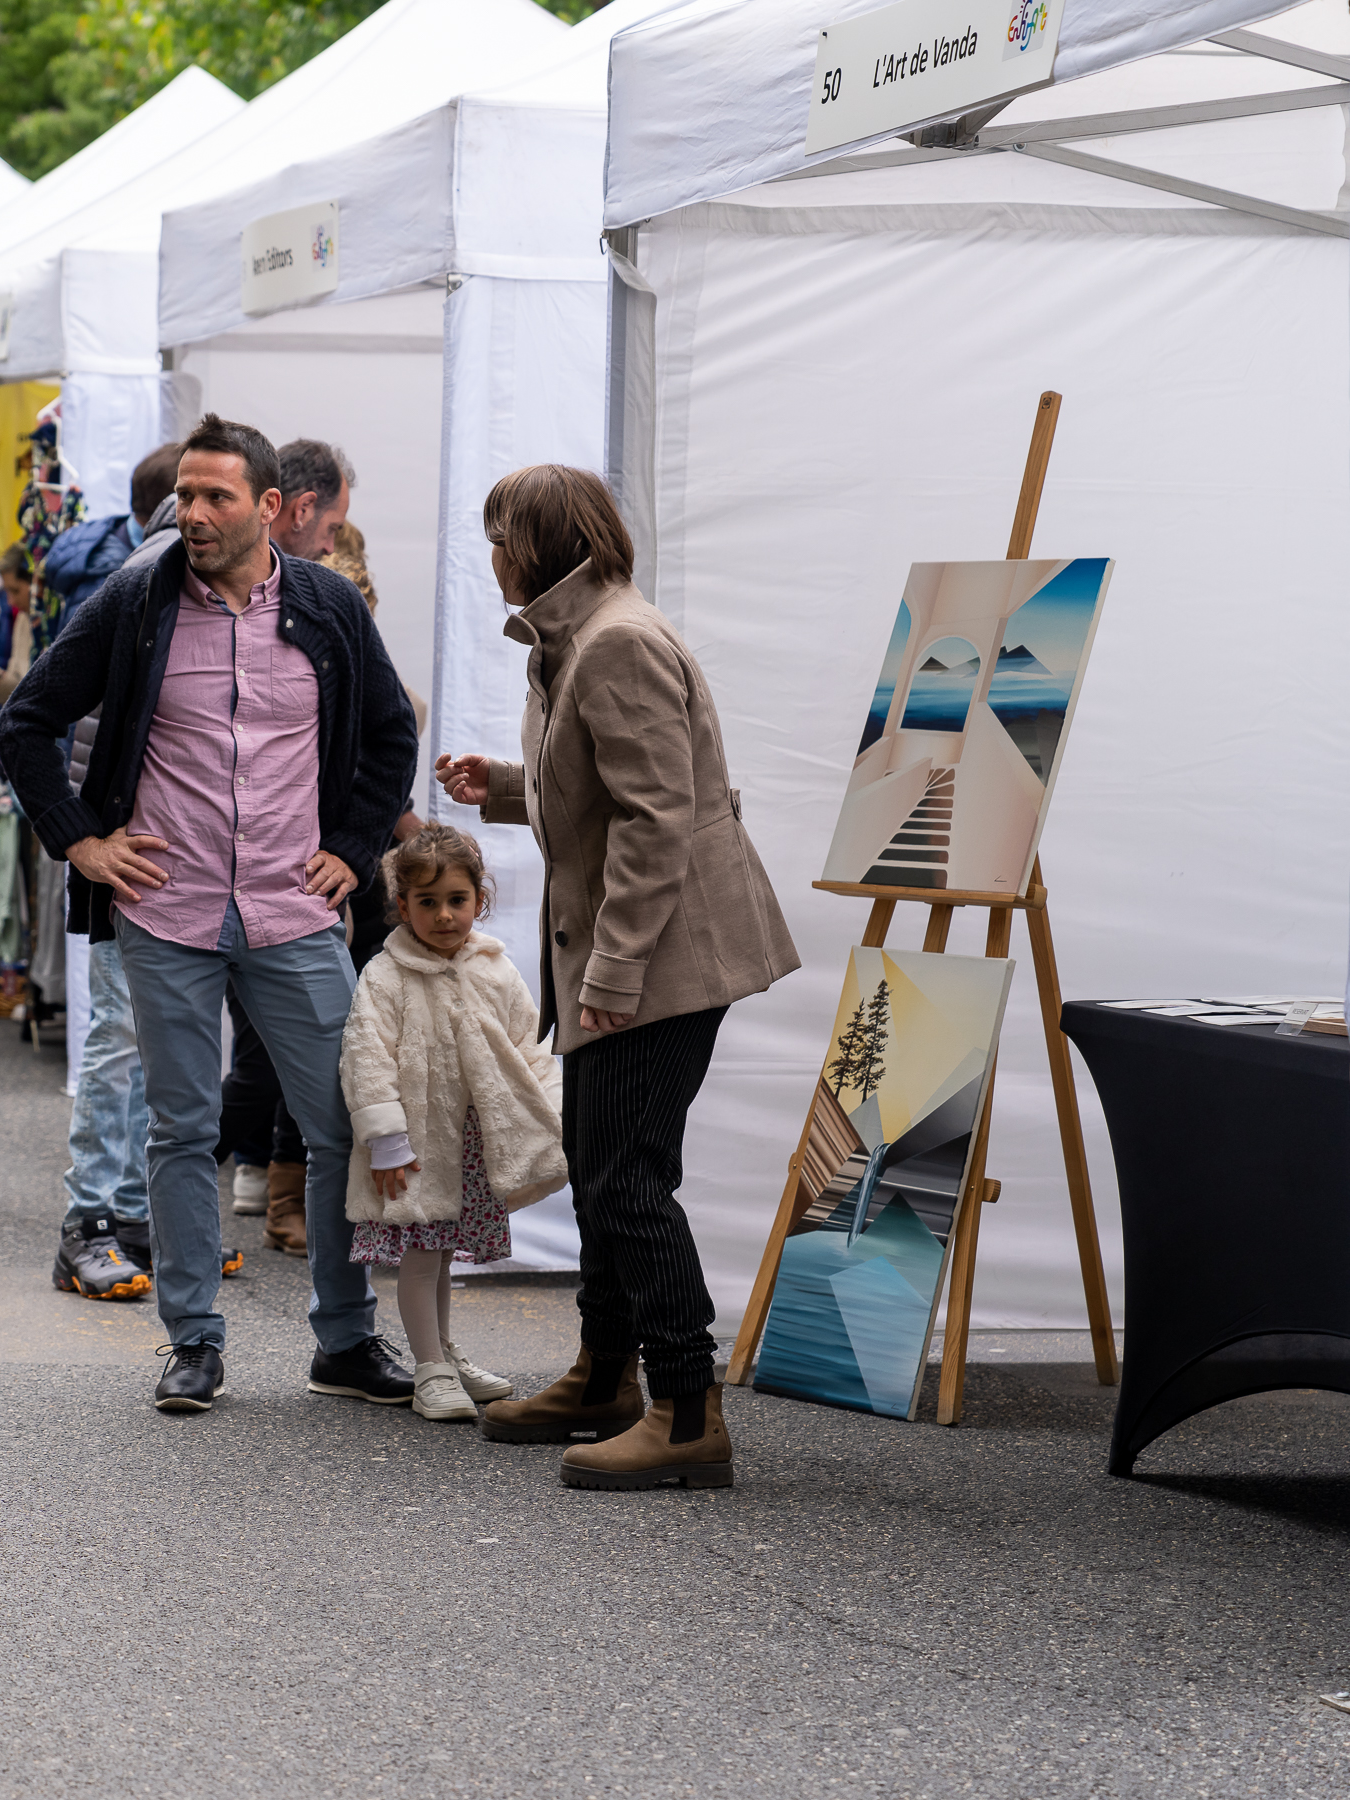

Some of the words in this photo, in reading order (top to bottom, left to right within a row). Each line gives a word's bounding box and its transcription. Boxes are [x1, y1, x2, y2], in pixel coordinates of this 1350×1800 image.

[821, 67, 842, 105] 50
[872, 51, 908, 89] L'Art
[909, 42, 929, 77] de
[933, 24, 978, 69] Vanda
